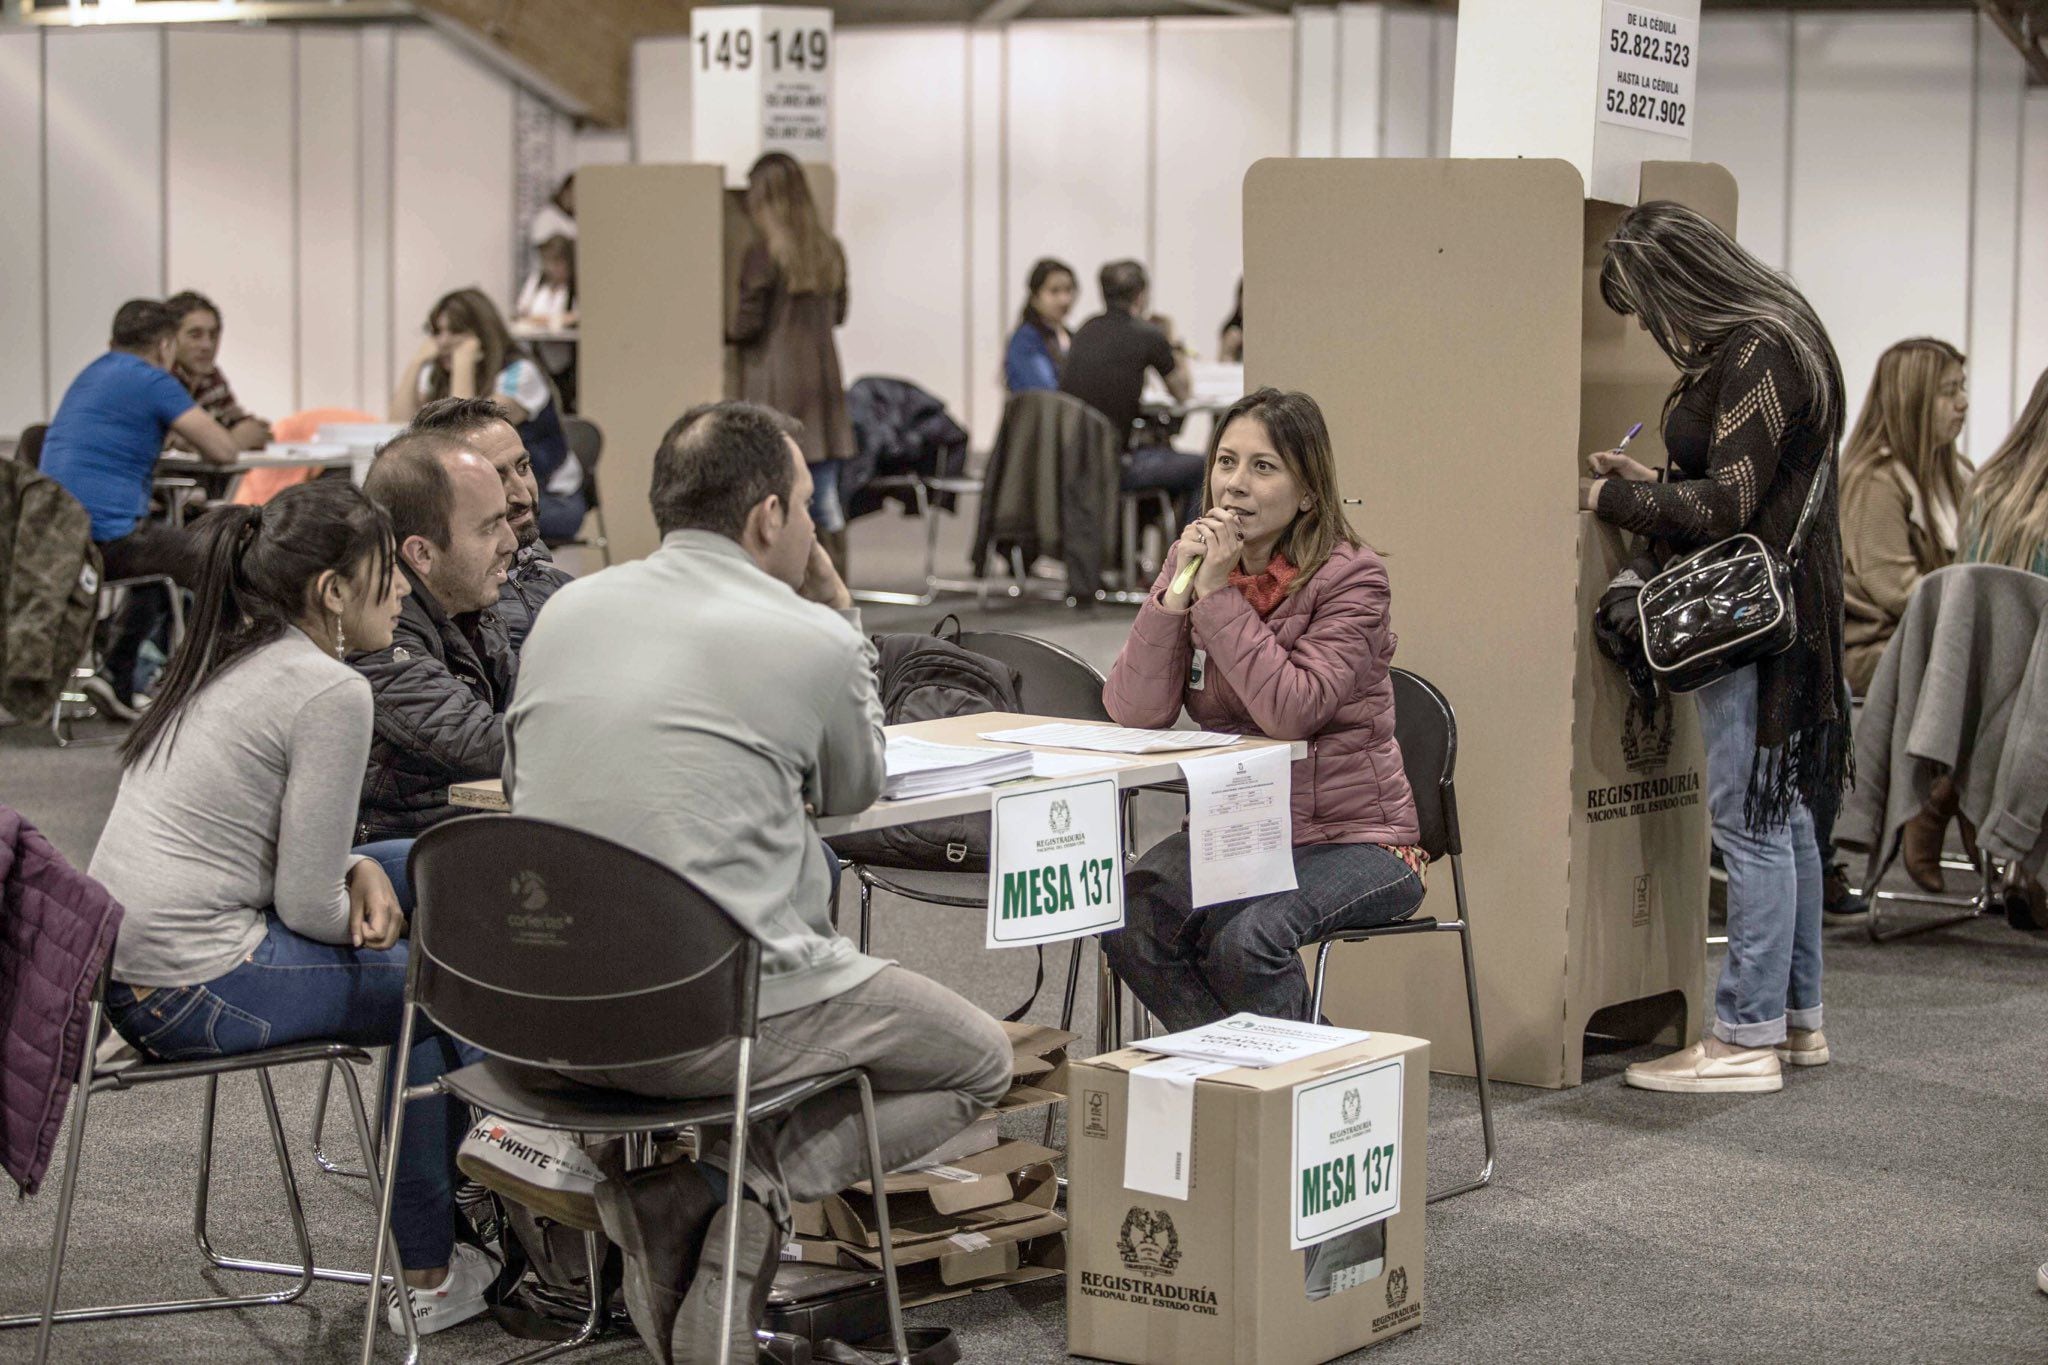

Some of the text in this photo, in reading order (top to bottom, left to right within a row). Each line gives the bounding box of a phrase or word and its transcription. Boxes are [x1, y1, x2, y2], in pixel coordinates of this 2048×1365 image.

[1627, 13, 1677, 35] DE LA CÉDULA
[695, 29, 752, 71] 149
[765, 28, 827, 72] 149
[1610, 29, 1690, 68] 52.822.523
[1617, 70, 1679, 95] HASTA LA CÉDULA
[1606, 88, 1686, 126] 52.827.902
[1587, 766, 1699, 809] REGISTRADURÍA
[1587, 793, 1699, 824] NACIONAL DEL ESTADO CIVIL
[1002, 857, 1113, 920] MESA 137
[1302, 1143, 1394, 1218] MESA 137
[1080, 1286, 1219, 1316] NACIONAL DEL ESTADO CIVIL
[1081, 1271, 1218, 1305] REGISTRADURÍA
